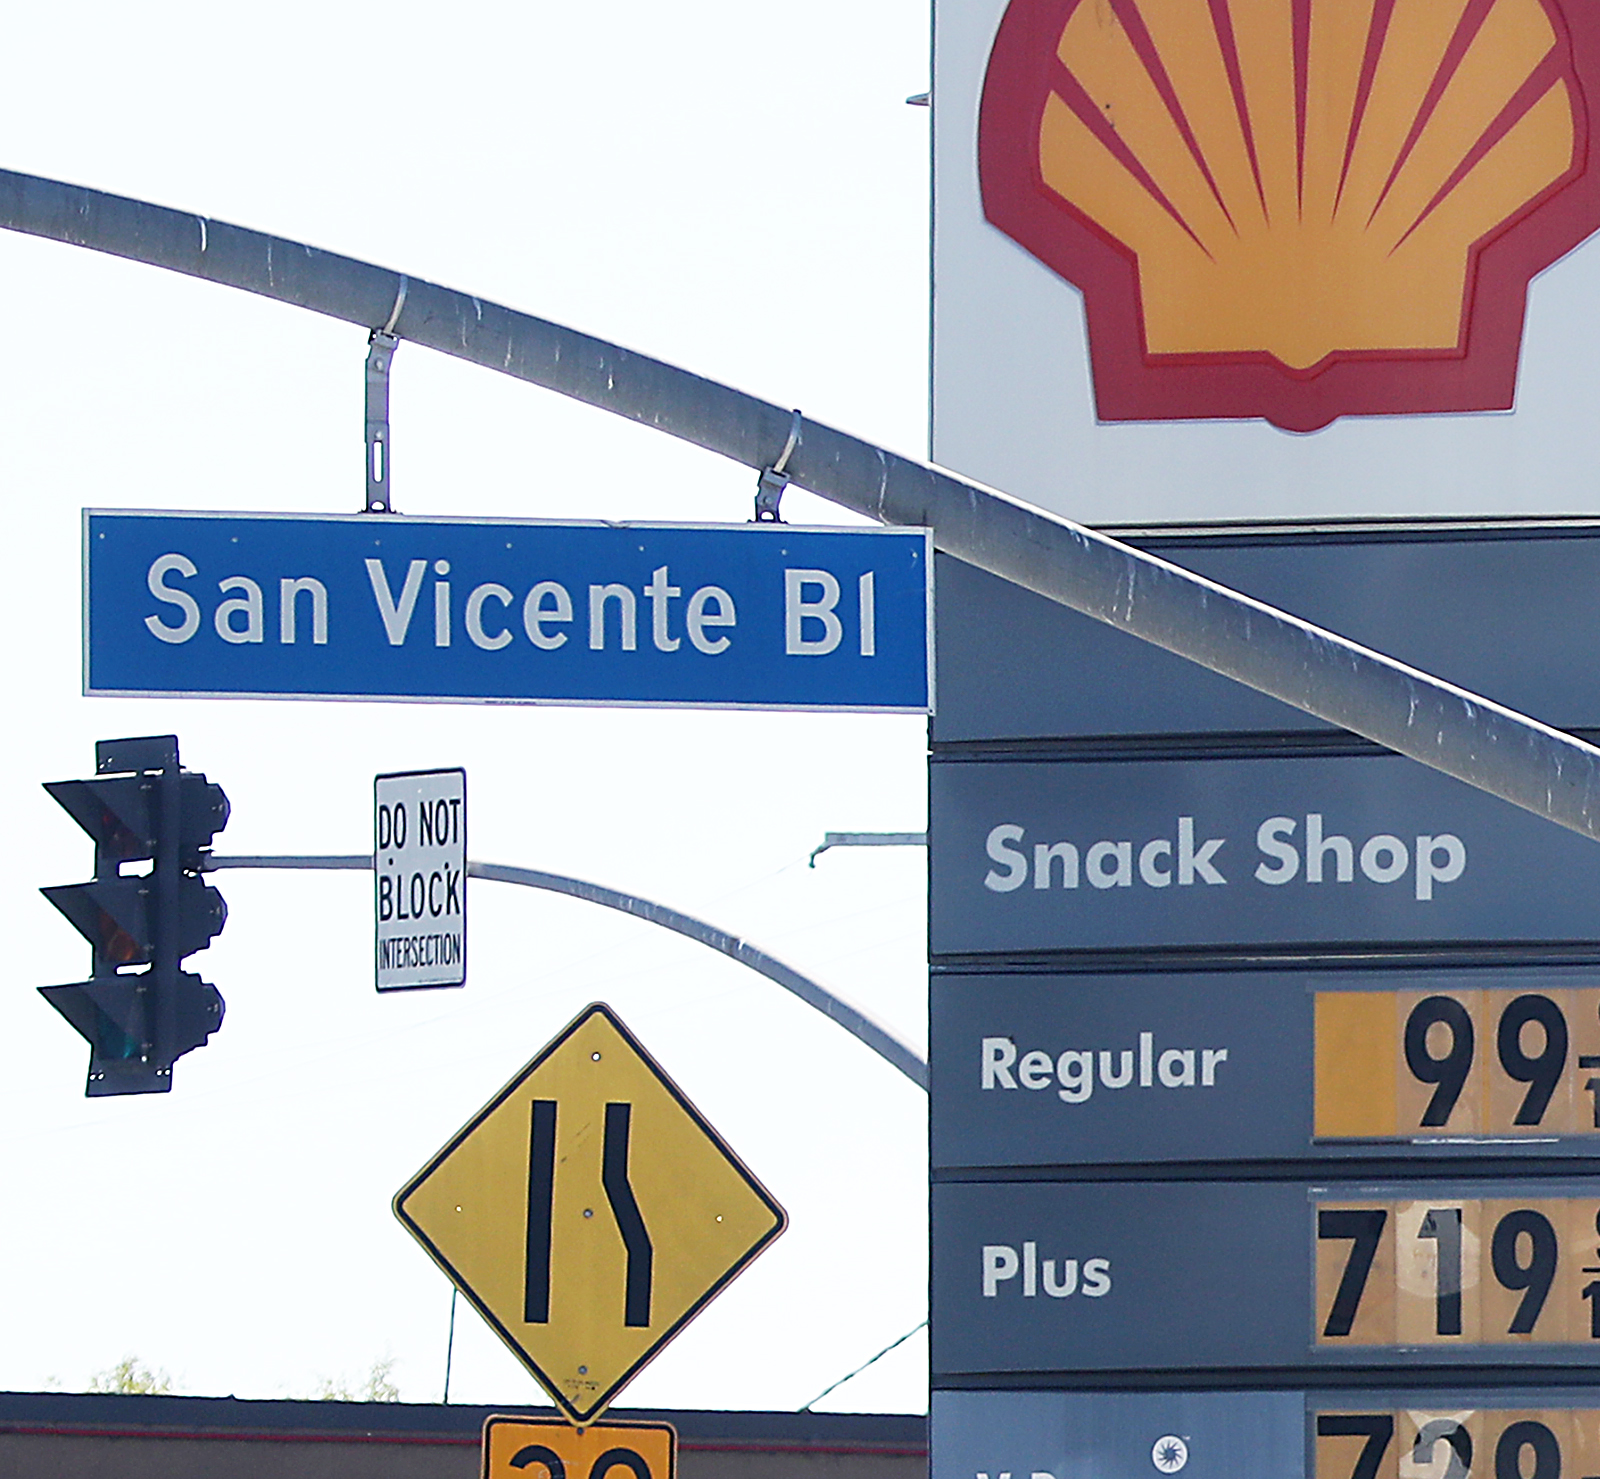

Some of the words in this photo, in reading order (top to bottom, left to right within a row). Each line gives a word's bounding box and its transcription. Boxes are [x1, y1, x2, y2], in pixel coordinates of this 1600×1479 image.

[145, 553, 328, 645] San
[365, 559, 737, 656] Vicente
[785, 569, 875, 657] Bl
[379, 802, 407, 849] DO
[420, 798, 461, 846] NOT
[983, 818, 1226, 892] Snack
[1254, 814, 1467, 900] Shop
[380, 870, 460, 921] BLOCK
[379, 933, 461, 970] INTERSECTION
[981, 1032, 1227, 1103] Regular
[1402, 994, 1569, 1128] 99
[982, 1243, 1112, 1298] Plus
[1316, 1208, 1559, 1338] 719
